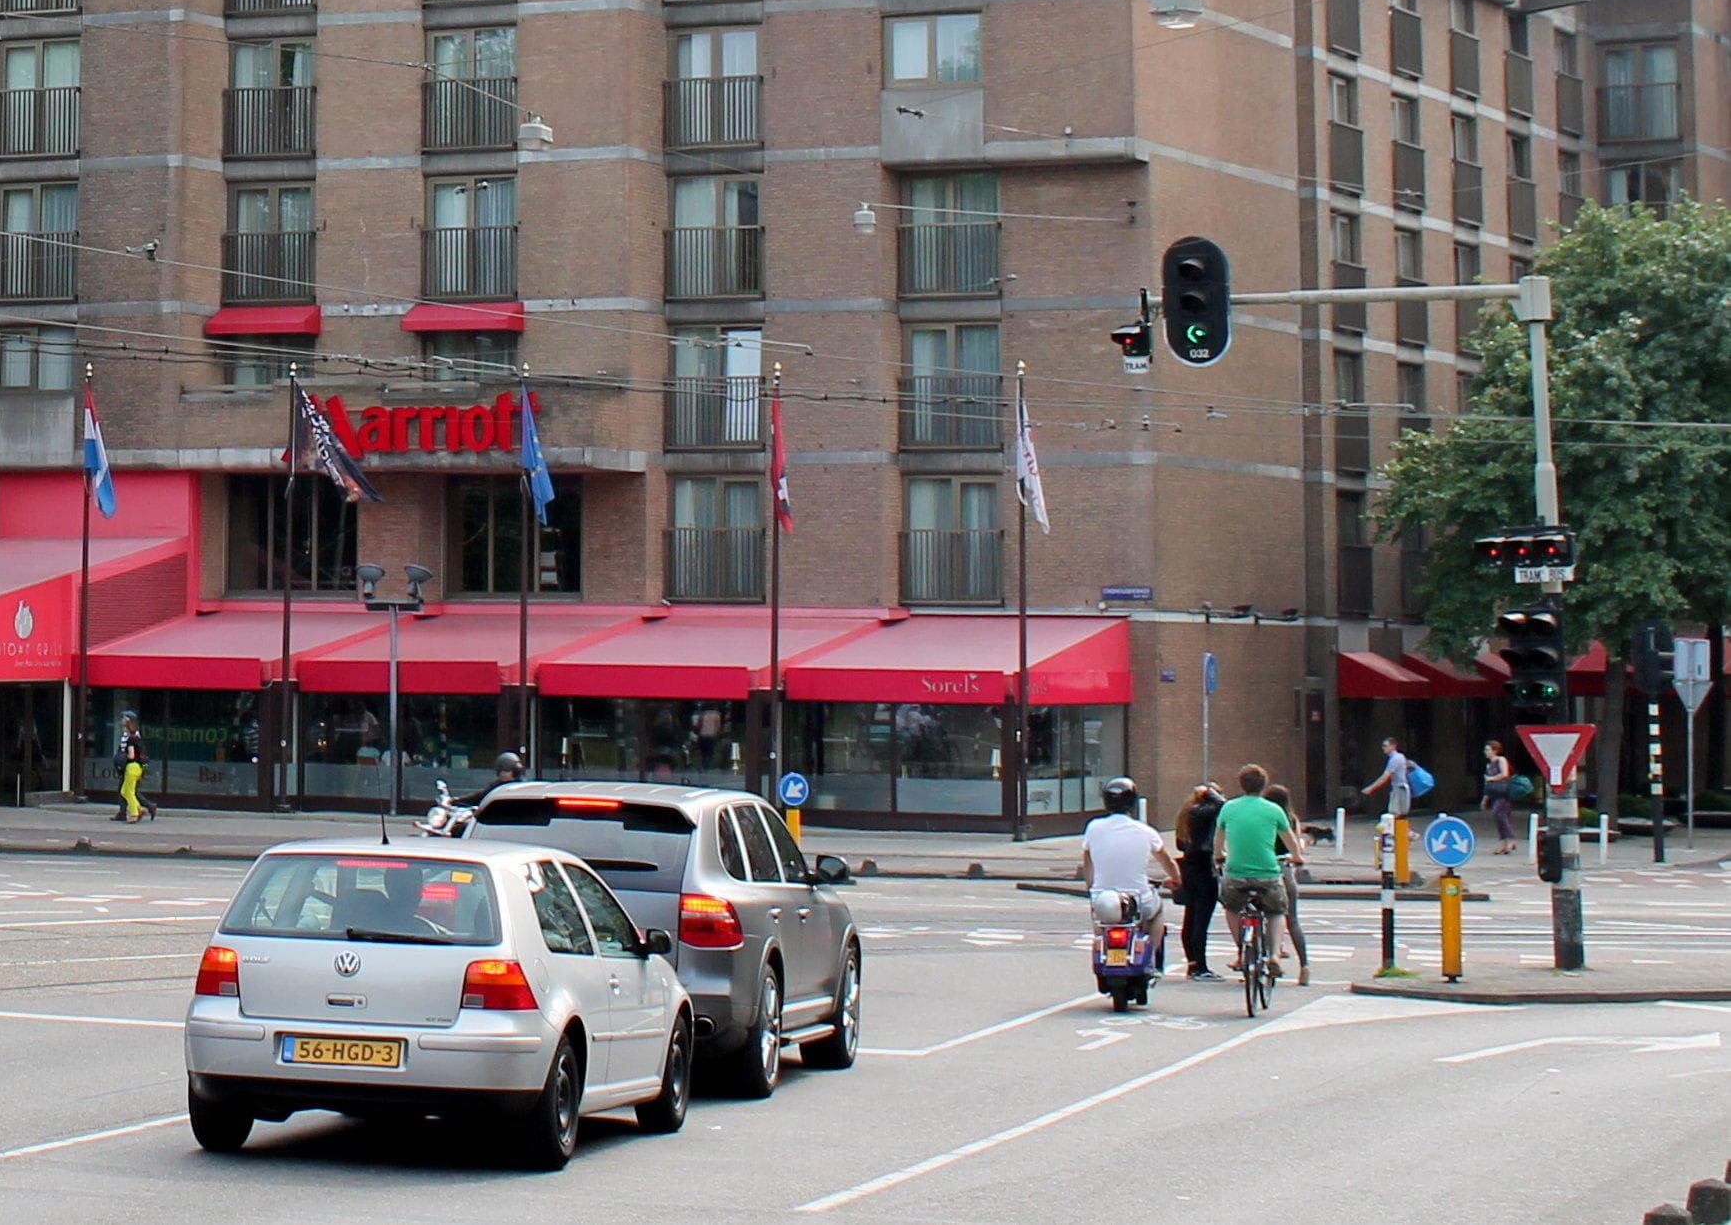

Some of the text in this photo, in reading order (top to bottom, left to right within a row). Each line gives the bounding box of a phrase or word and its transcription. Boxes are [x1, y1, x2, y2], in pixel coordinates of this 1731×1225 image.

[1189, 348, 1210, 359] 032
[1125, 362, 1148, 370] TRAM
[1518, 568, 1567, 583] TRAM BUS
[298, 1040, 394, 1063] 56-HGD-3
